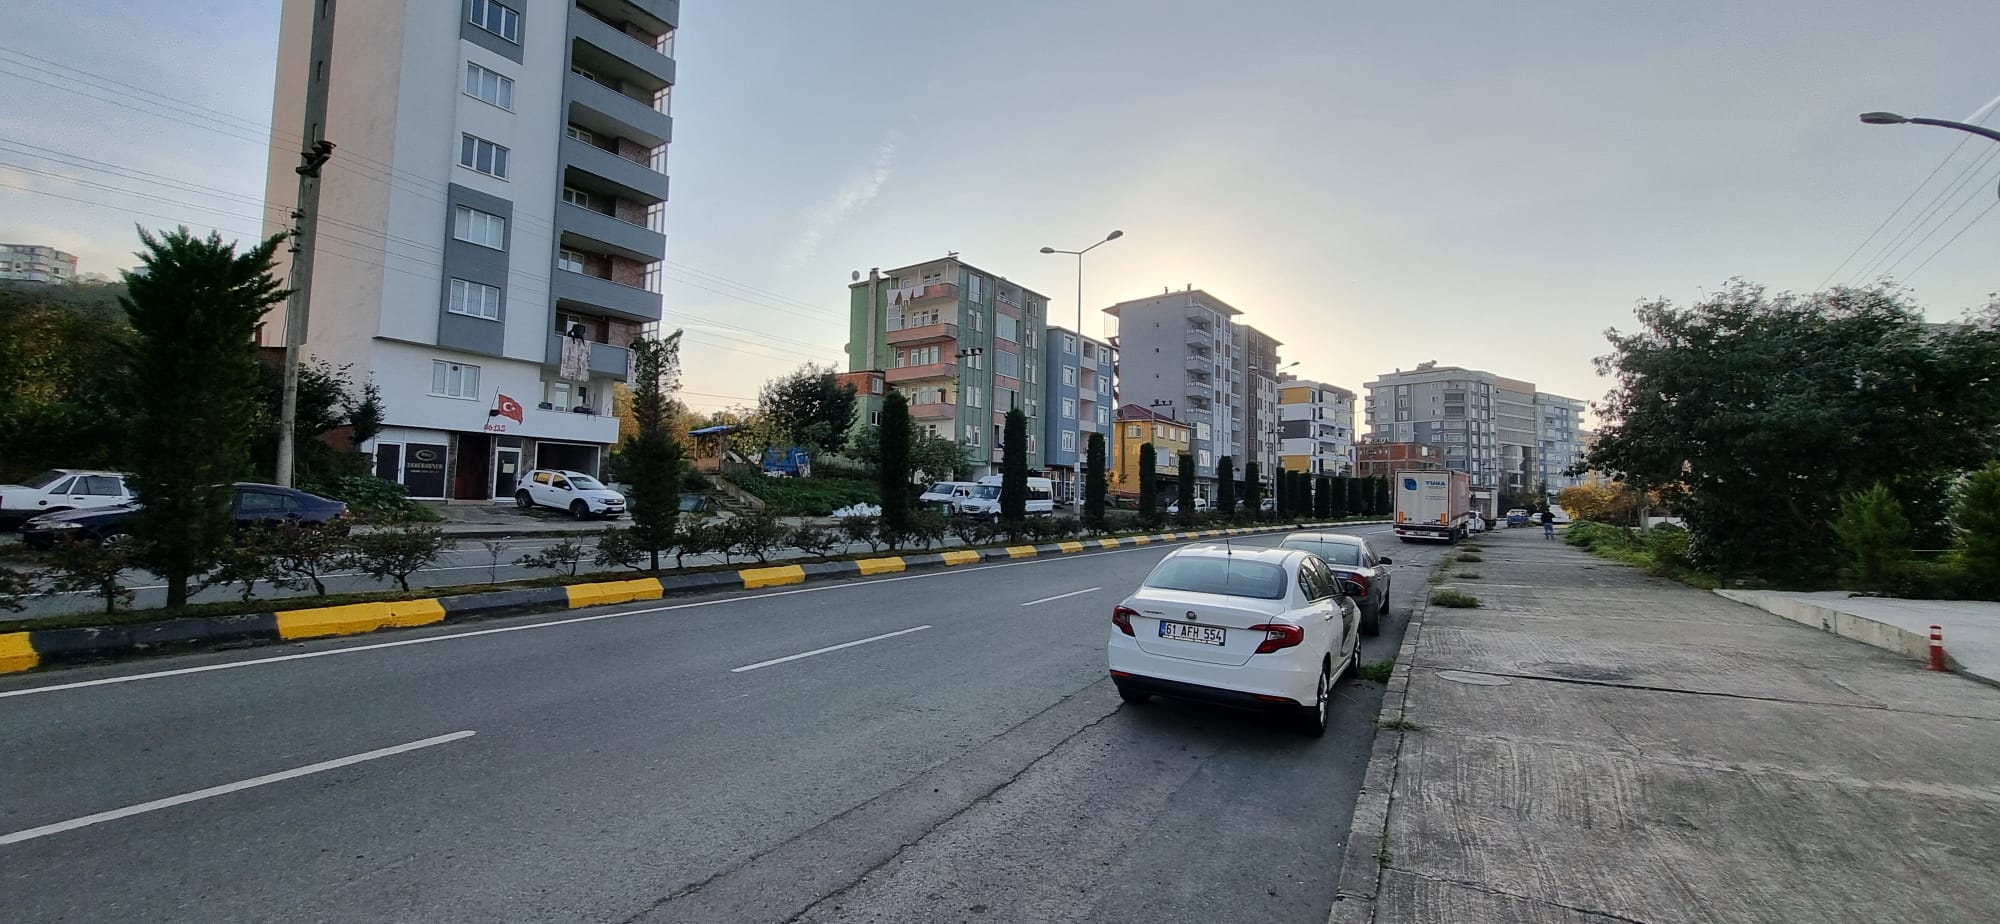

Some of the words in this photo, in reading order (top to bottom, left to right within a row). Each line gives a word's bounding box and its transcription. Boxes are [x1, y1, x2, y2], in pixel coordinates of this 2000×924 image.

[1166, 623, 1176, 635] 61
[1180, 625, 1199, 638] AFH
[1204, 628, 1222, 641] 554
